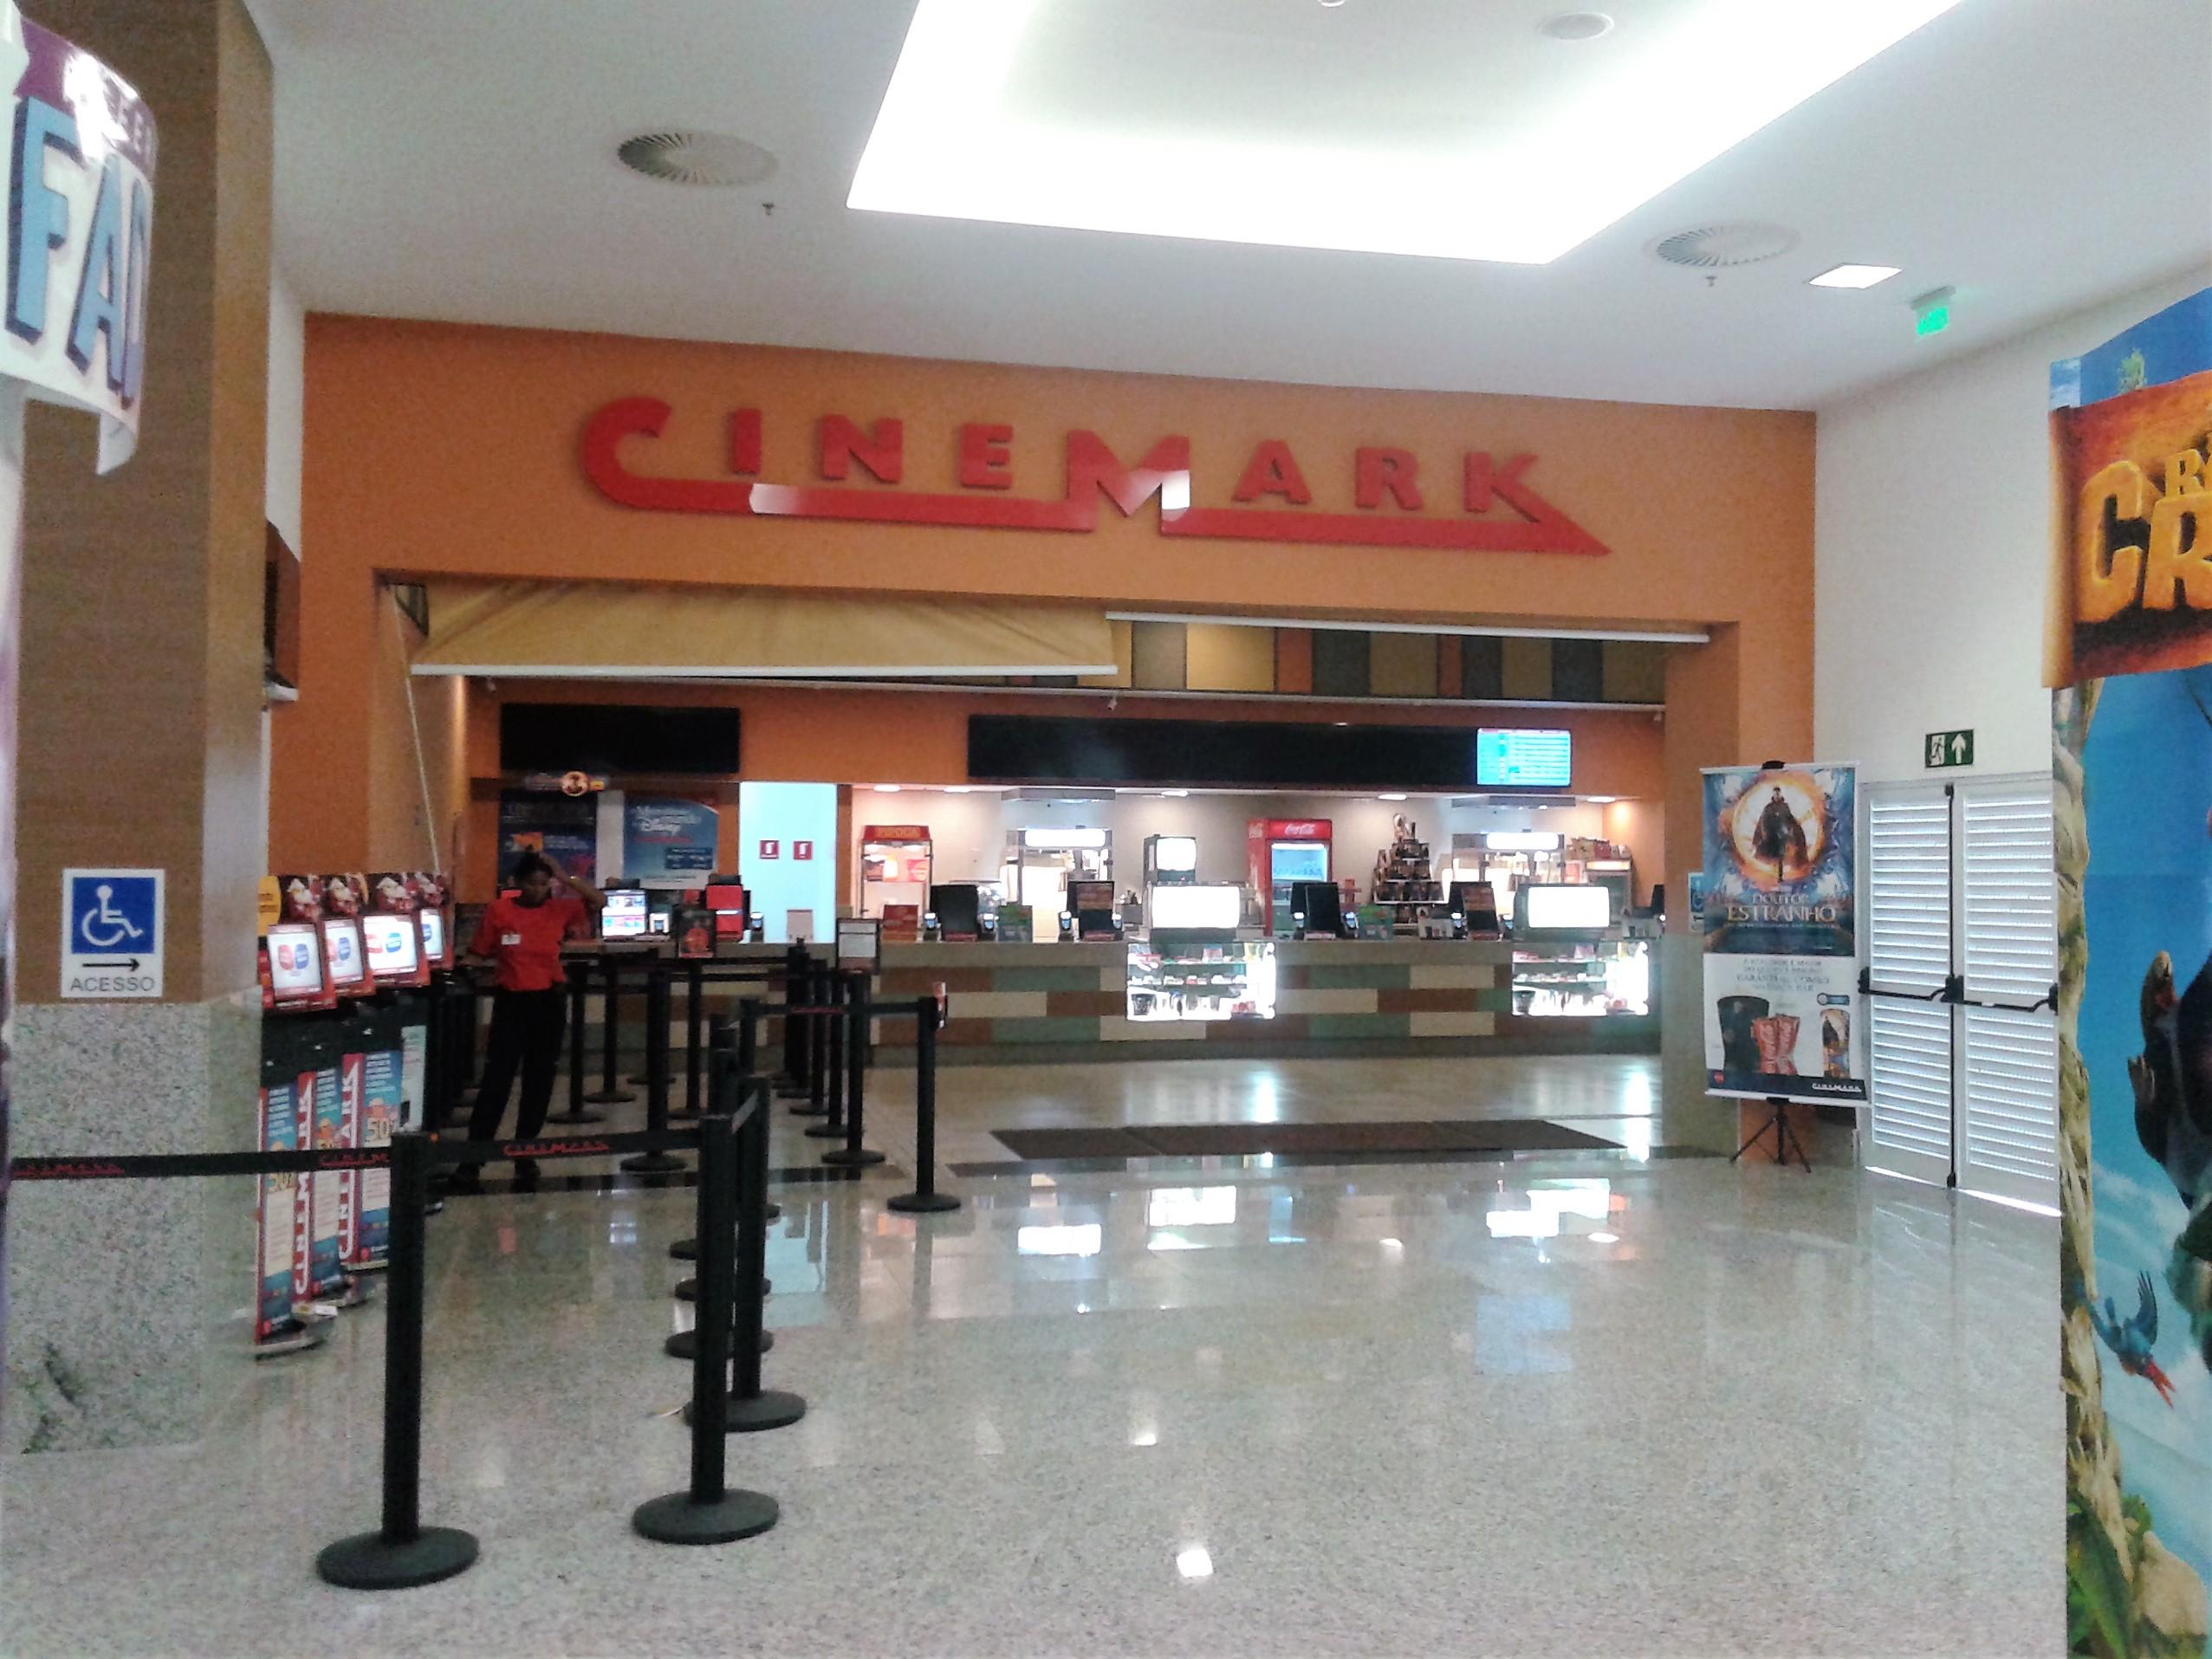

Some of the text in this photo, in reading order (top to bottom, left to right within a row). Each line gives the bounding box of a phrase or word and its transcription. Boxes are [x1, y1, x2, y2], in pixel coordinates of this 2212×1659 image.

[579, 396, 1612, 556] CINEMARK
[1727, 904, 1837, 923] ESTRANHO
[70, 975, 155, 992] ACESSO
